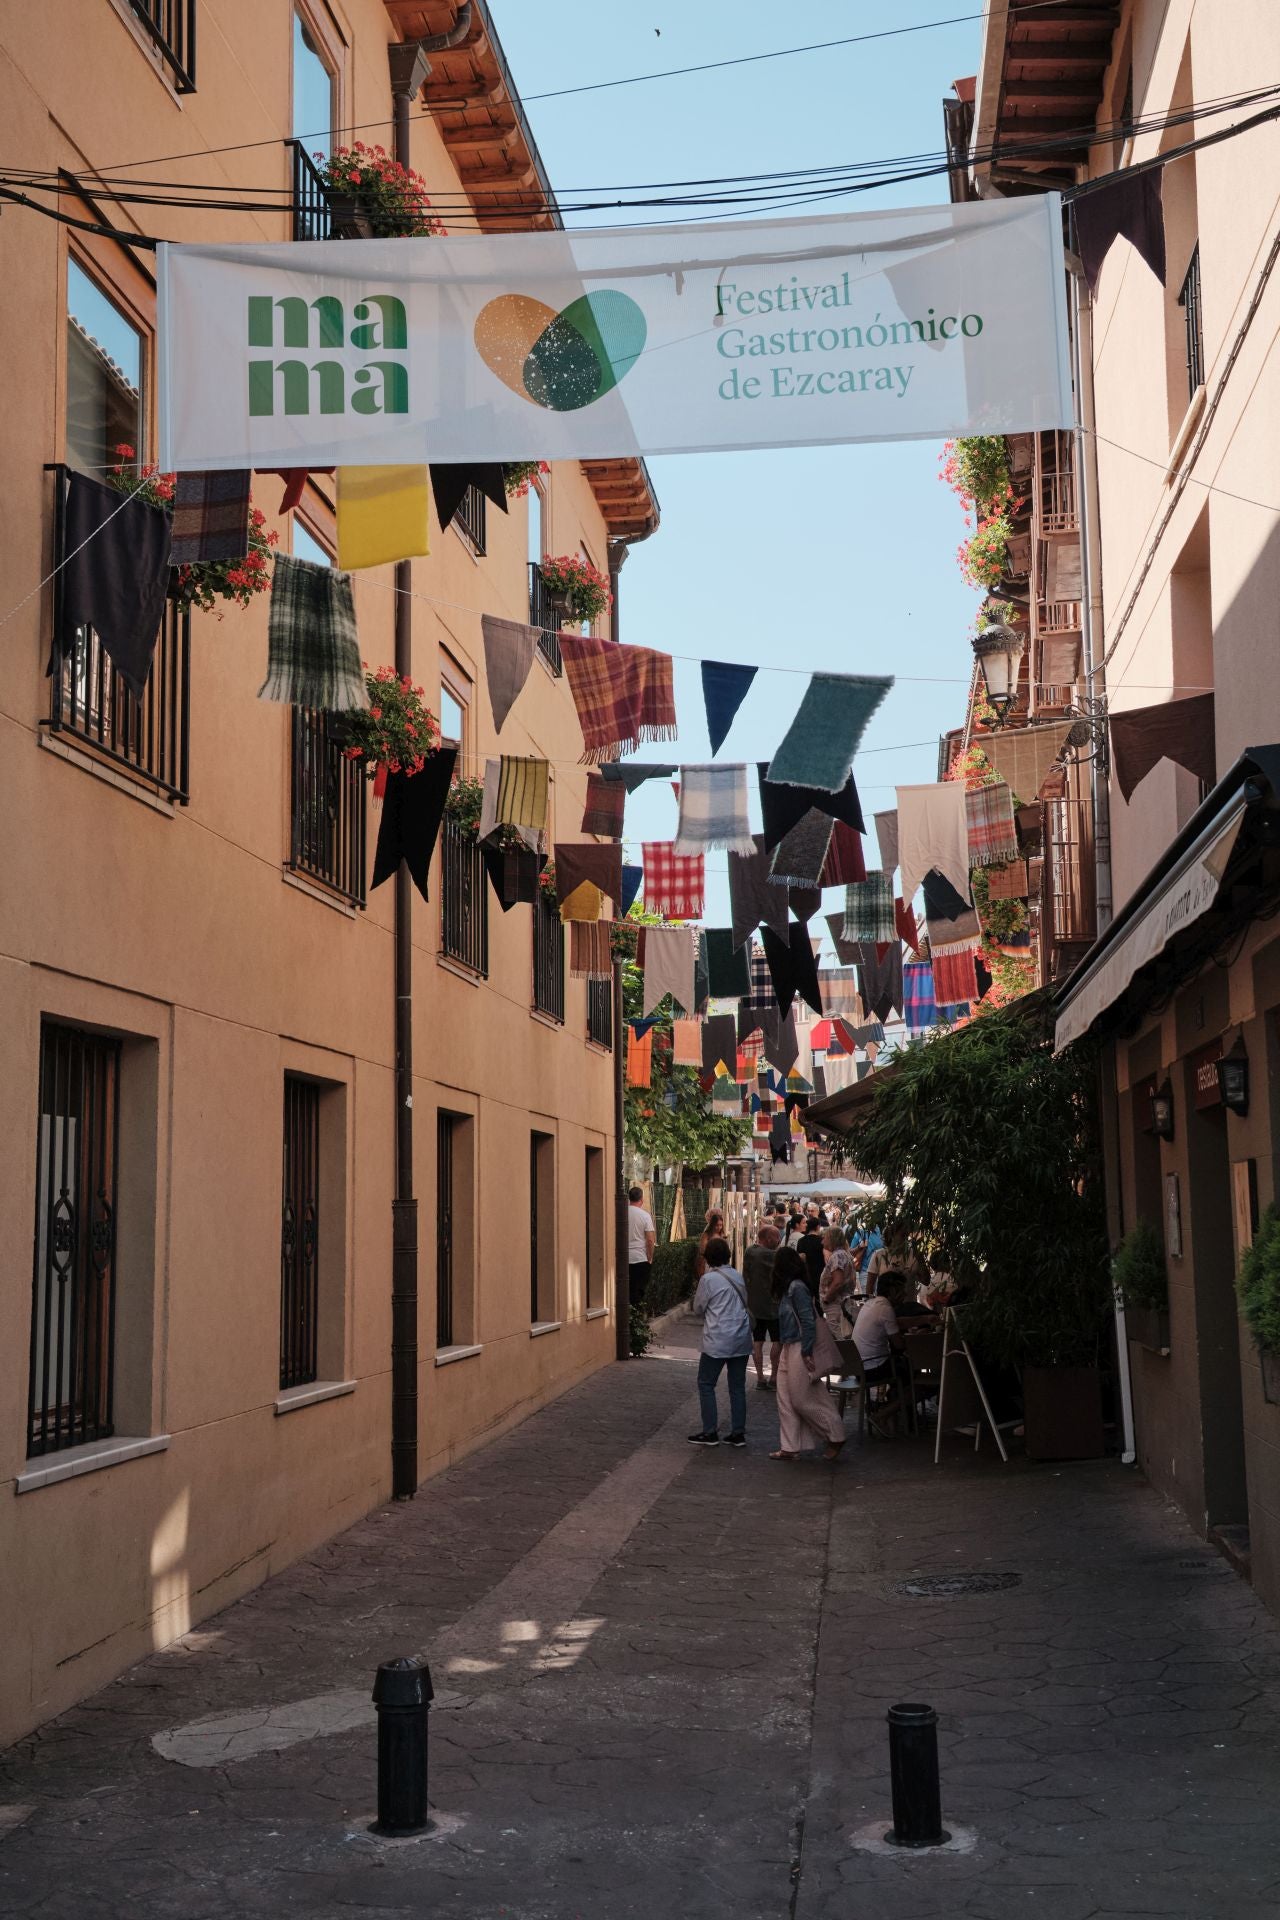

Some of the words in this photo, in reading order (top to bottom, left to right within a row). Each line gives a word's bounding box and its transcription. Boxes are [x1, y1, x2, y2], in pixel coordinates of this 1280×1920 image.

[714, 272, 852, 317] Festival
[248, 294, 408, 350] ma
[716, 308, 984, 359] Gastronómico
[248, 359, 409, 417] ma
[718, 368, 762, 401] de
[769, 364, 915, 399] Ezcaray
